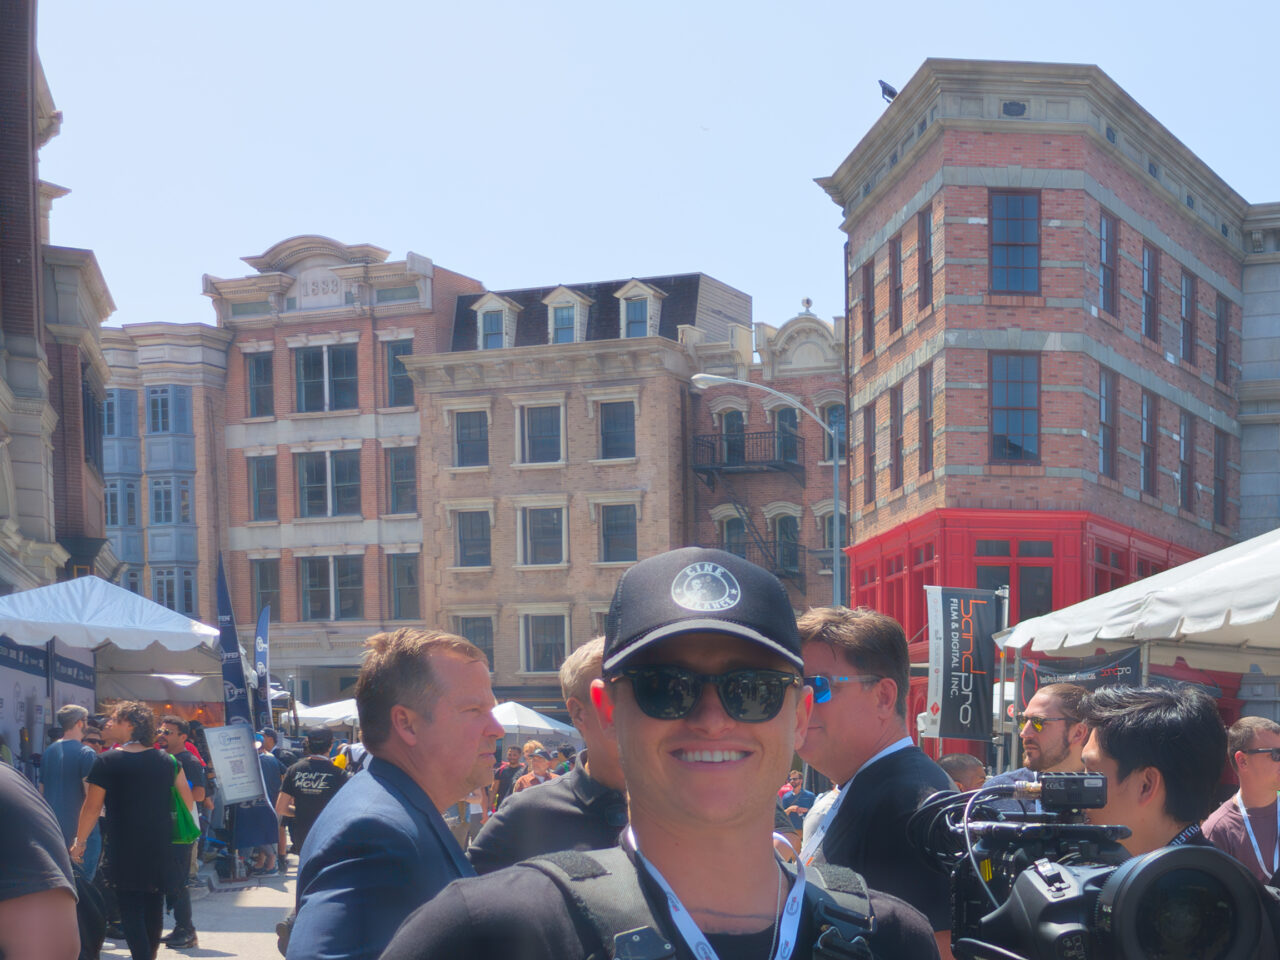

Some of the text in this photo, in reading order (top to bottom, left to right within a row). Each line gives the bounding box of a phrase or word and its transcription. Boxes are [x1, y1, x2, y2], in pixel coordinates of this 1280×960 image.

[685, 562, 726, 577] CINE
[950, 598, 959, 621] FILM
[951, 632, 959, 667] DIGITAL
[951, 599, 988, 725] bandpro
[950, 677, 959, 698] INC.
[295, 771, 333, 782] DON'T
[295, 780, 331, 788] MOVE
